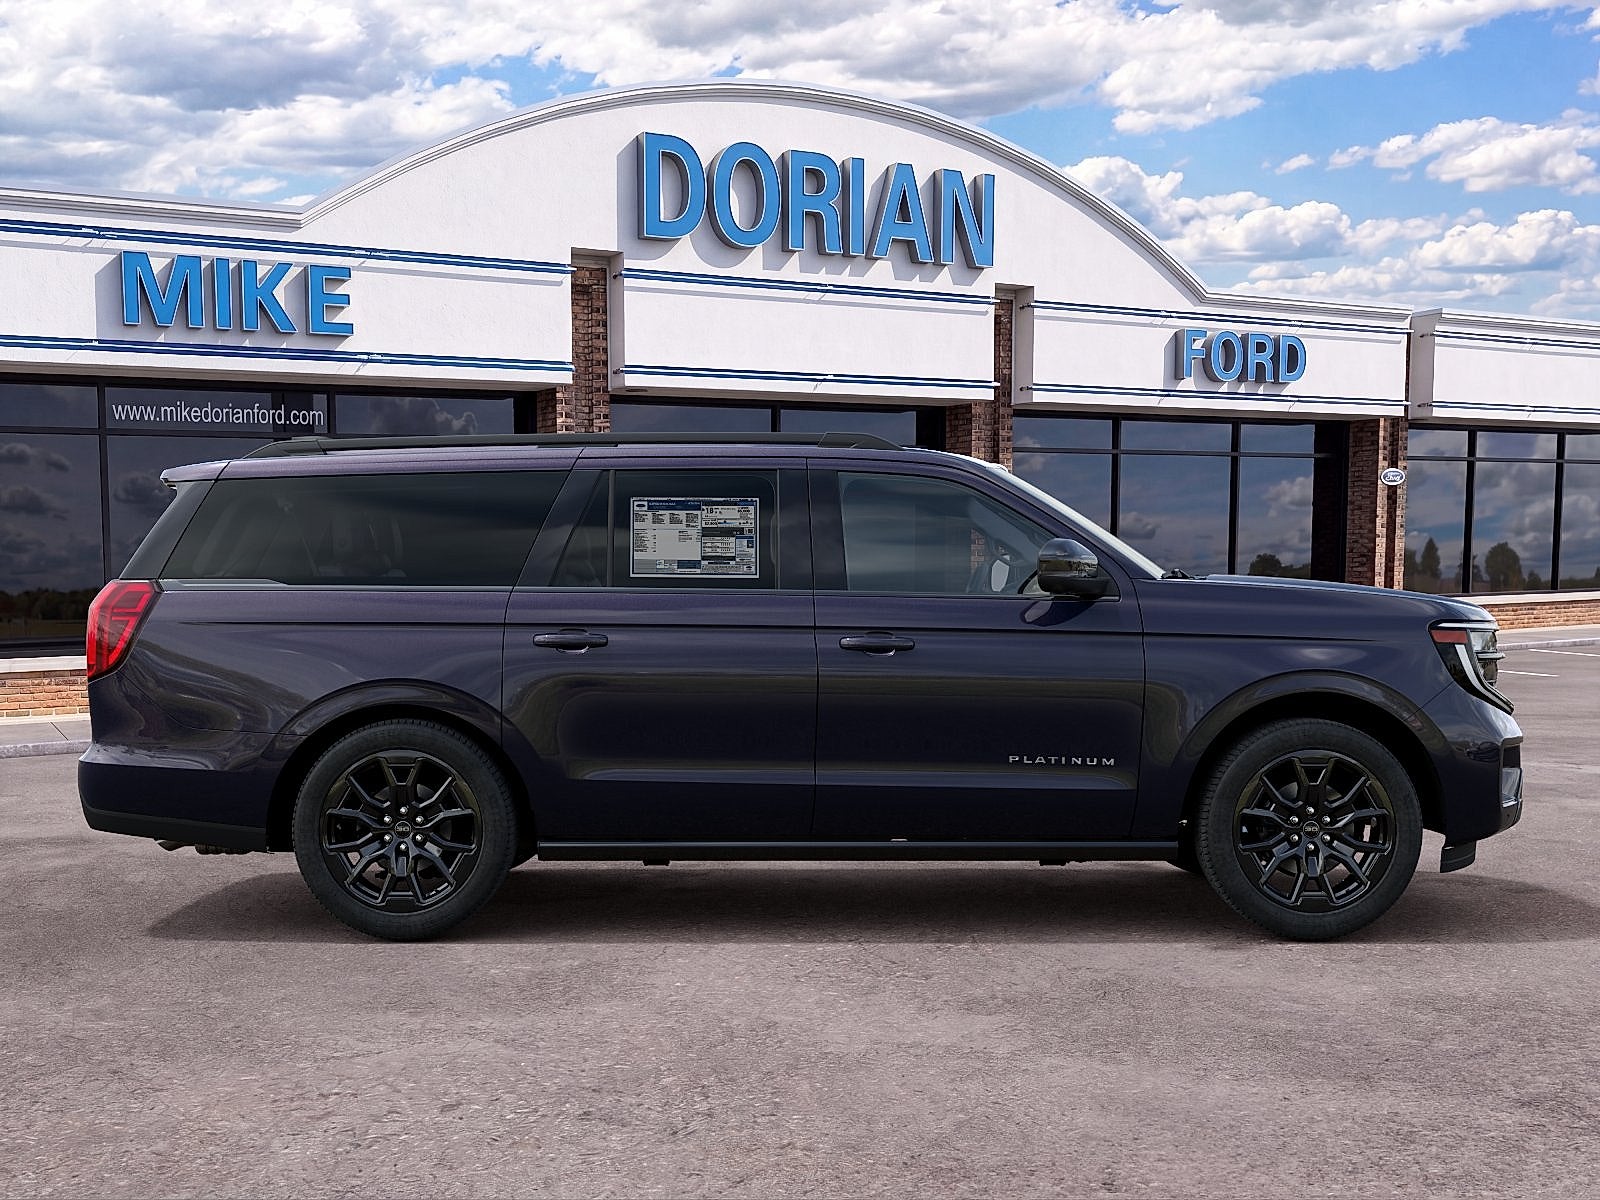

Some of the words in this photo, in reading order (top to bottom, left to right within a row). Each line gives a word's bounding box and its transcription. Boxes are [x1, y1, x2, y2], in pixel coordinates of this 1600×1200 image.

[637, 131, 996, 269] DORIAN
[120, 250, 354, 336] MIKE
[1176, 328, 1307, 384] FORD
[111, 401, 325, 426] www.mikedorianford.com
[1008, 755, 1115, 766] PLATINUM
